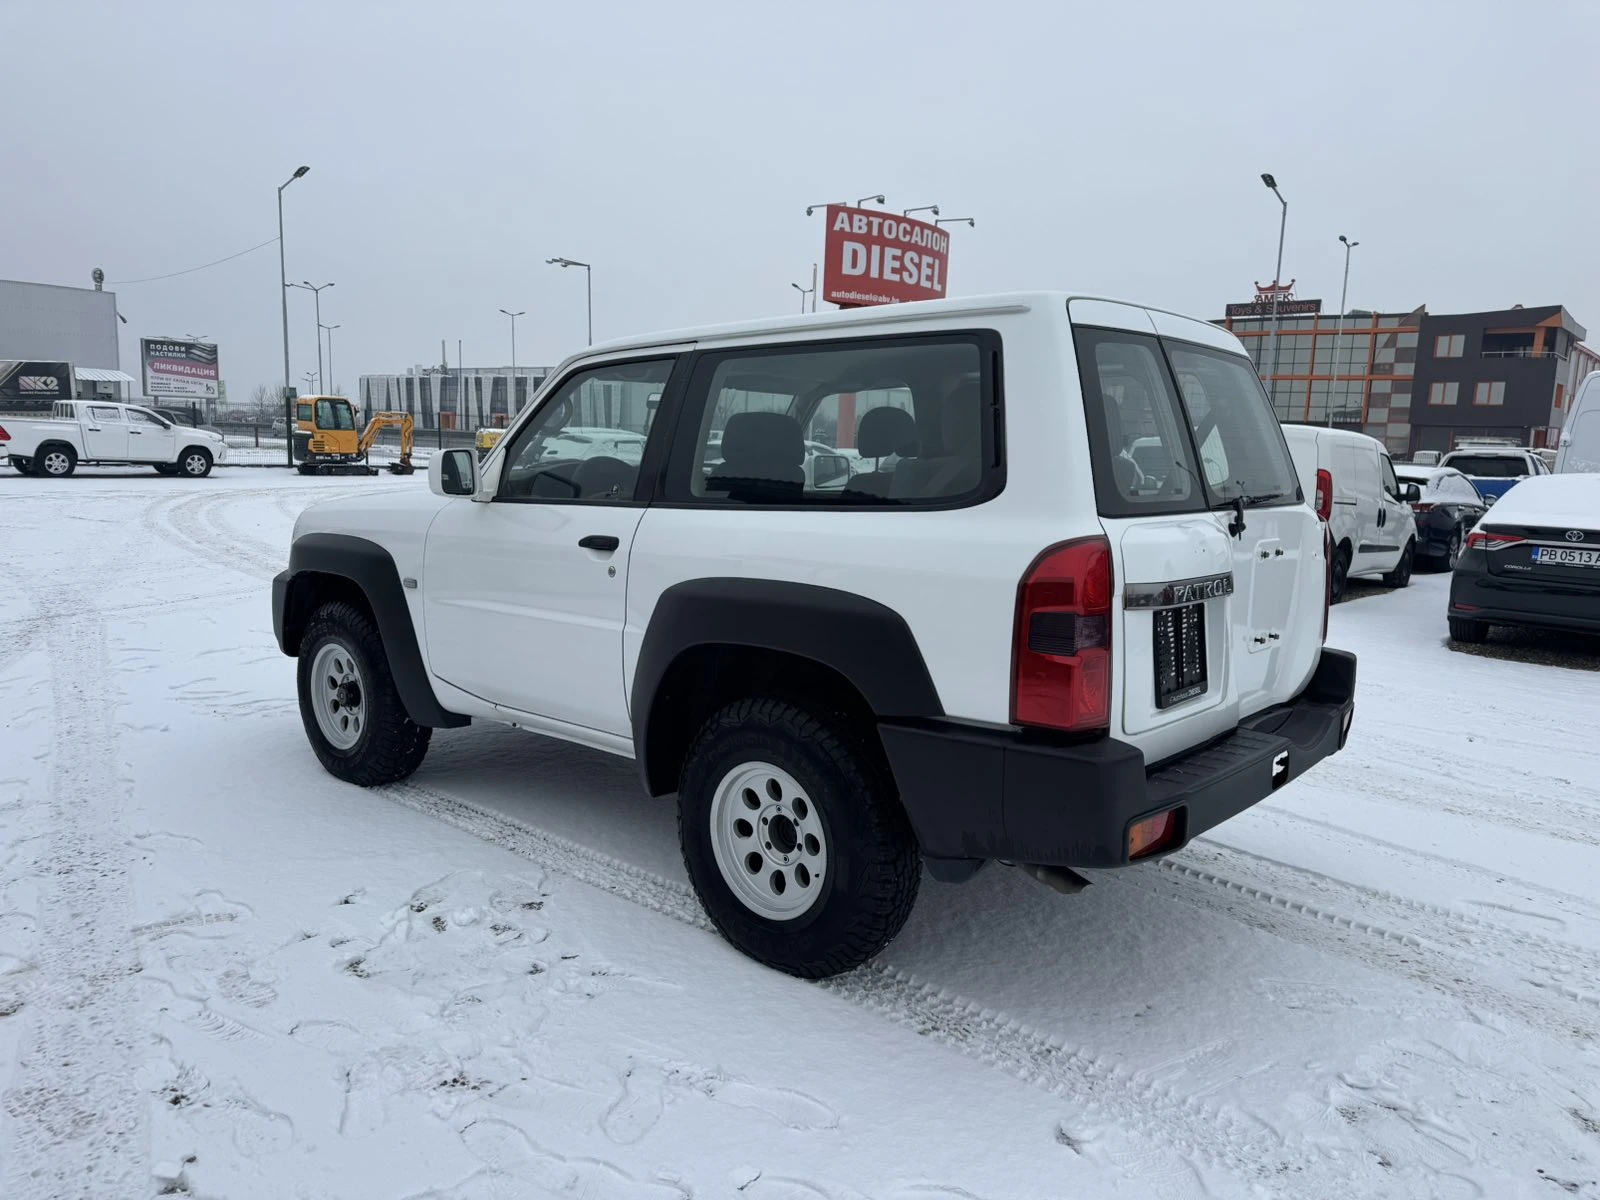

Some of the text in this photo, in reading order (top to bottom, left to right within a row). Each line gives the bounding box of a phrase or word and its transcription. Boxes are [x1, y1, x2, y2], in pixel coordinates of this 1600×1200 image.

[833, 212, 947, 254] АВТОСАЛОН
[841, 240, 943, 292] DIESEL
[1230, 302, 1316, 315] Toys & Suvenirs
[149, 344, 186, 352] ПОДОВИ
[153, 362, 215, 377] ЛИКВИДАЦИЯ
[1540, 548, 1557, 561] PB
[1560, 550, 1592, 563] 0513
[1173, 578, 1232, 604] PATROL
